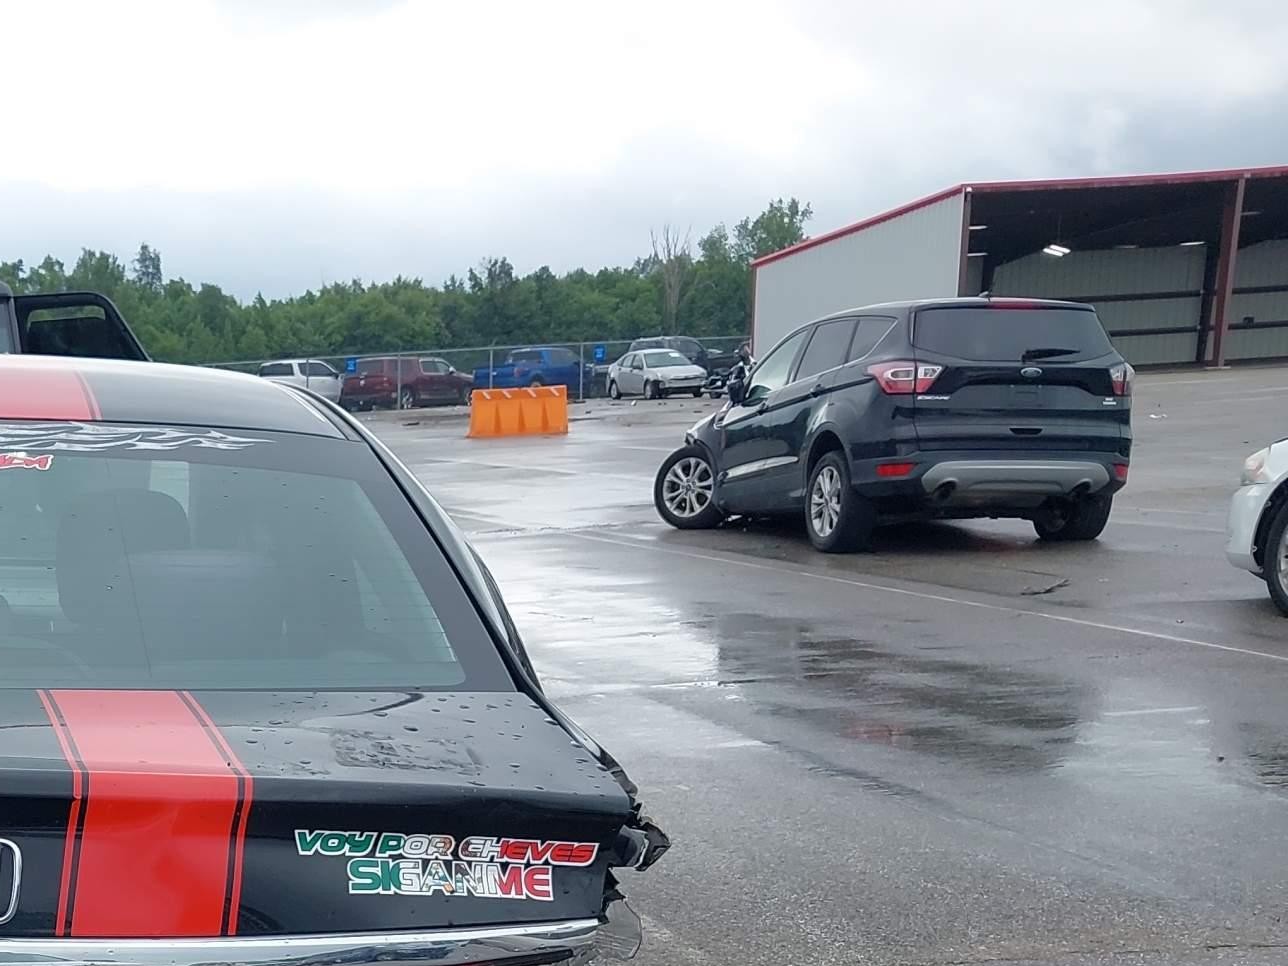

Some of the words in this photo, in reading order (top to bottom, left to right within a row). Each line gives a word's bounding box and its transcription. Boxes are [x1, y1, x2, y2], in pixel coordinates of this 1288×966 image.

[295, 830, 378, 855] VOY
[377, 834, 453, 860] POR
[459, 836, 600, 867] CHEVES
[347, 857, 554, 901] SIGANME
